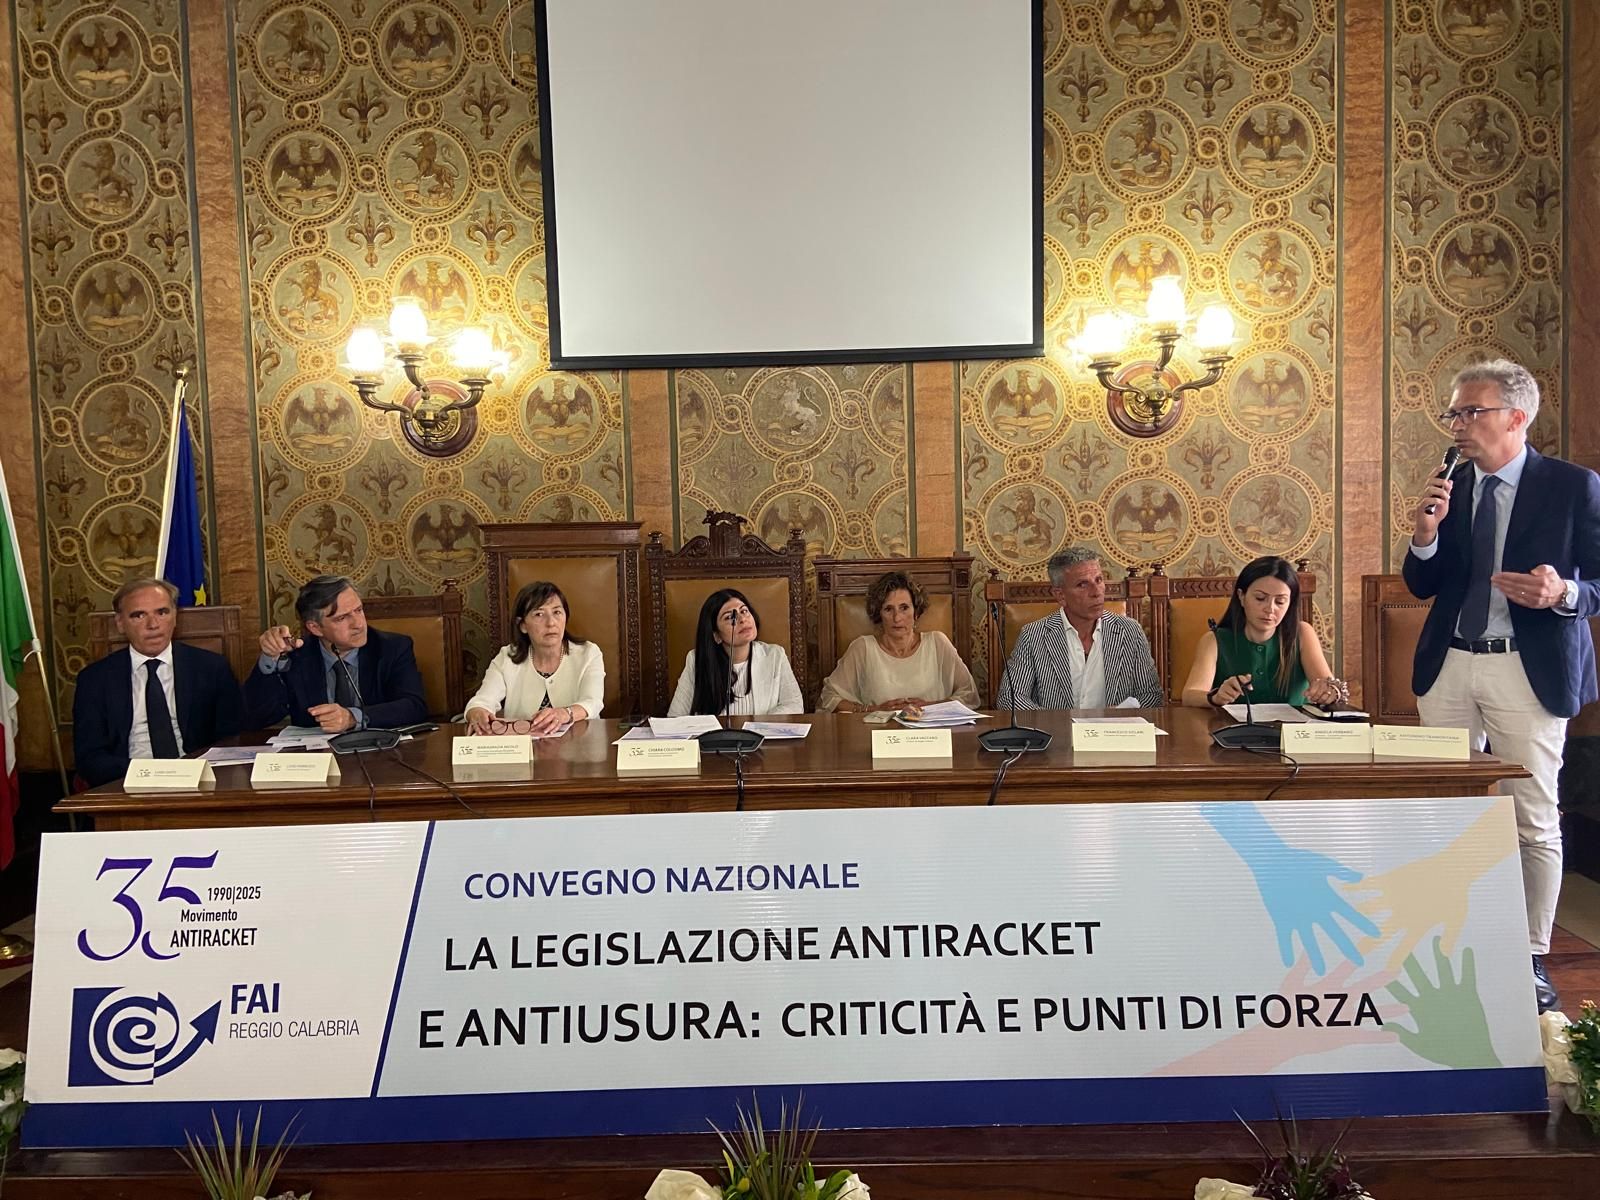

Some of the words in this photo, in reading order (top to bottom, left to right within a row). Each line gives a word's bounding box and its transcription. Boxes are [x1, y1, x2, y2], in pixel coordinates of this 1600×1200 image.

[464, 868, 656, 899] CONVEGNO
[666, 862, 860, 893] NAZIONALE
[77, 850, 223, 962] 35
[180, 908, 238, 923] Movimento
[169, 927, 258, 948] ANTIRACKET
[445, 936, 498, 972] LA
[511, 926, 820, 969] LEGISLAZIONE
[829, 921, 1101, 960] ANTIRACKET
[230, 982, 280, 1015] FAI
[229, 1022, 283, 1039] REGGIO
[288, 1019, 360, 1038] CALABRIA
[419, 1009, 445, 1049] E
[455, 1000, 760, 1048] ANTIUSURA:
[781, 991, 986, 1038] CRITICITÀ
[997, 998, 1021, 1033] E
[1033, 996, 1167, 1032] PUNTI
[1179, 995, 1222, 1030] DI
[1235, 992, 1385, 1029] FORZA
